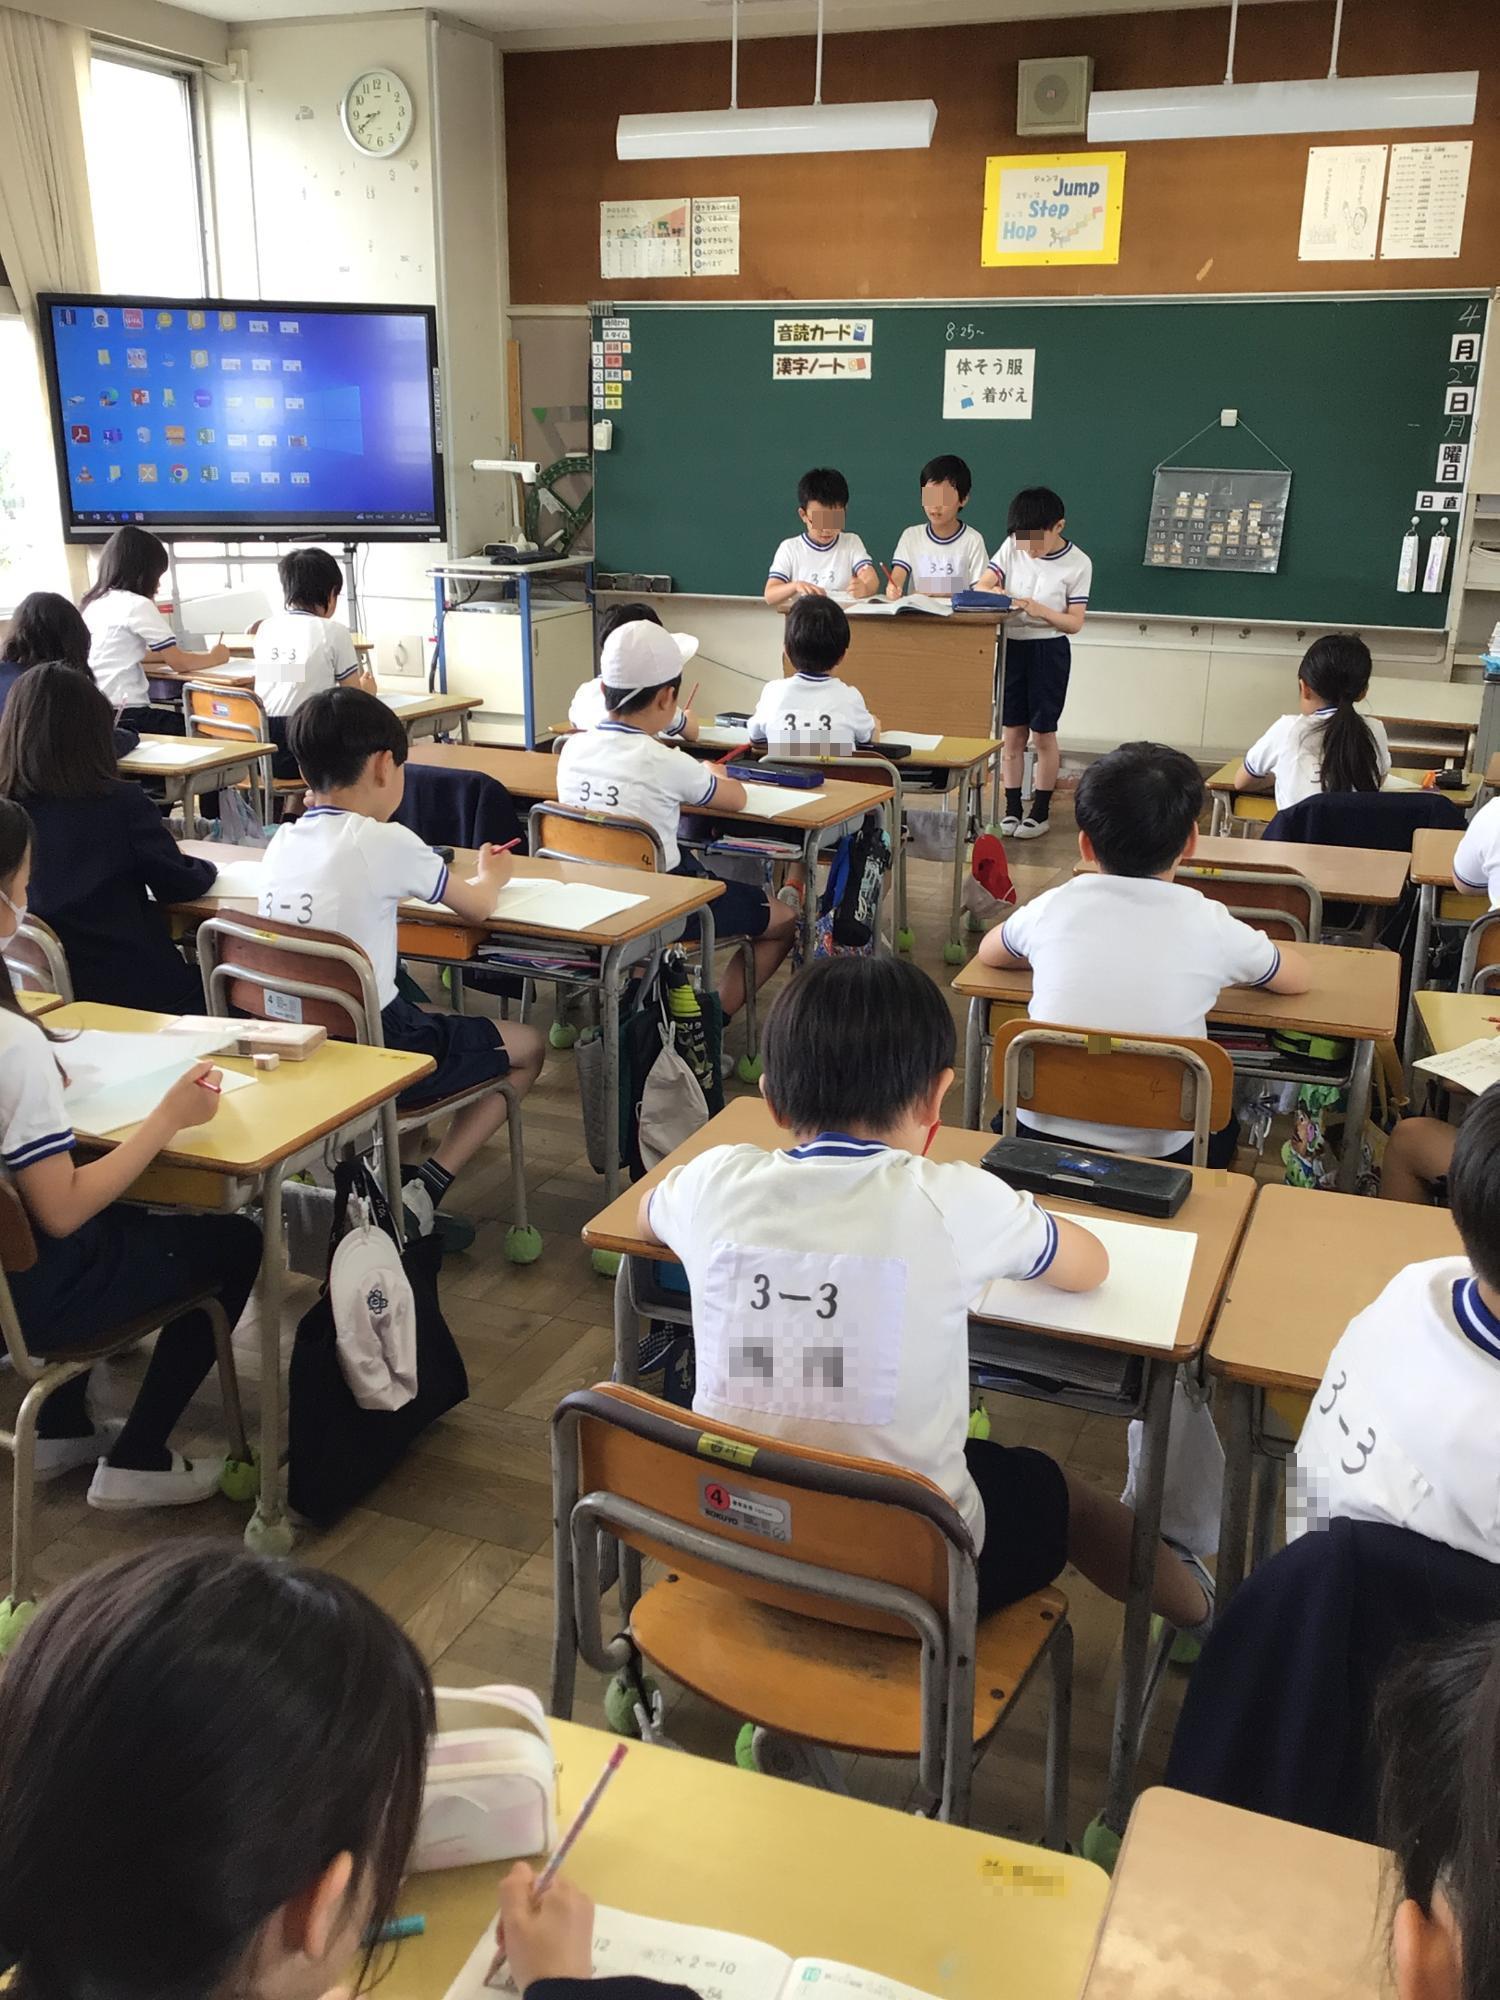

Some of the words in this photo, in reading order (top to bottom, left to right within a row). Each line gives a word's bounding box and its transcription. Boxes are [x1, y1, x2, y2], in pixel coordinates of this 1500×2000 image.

[362, 83, 370, 94] 11
[372, 79, 382, 90] 12
[386, 82, 391, 92] 1
[355, 95, 365, 106] 10
[394, 92, 400, 103] 2
[353, 110, 360, 121] 9
[398, 106, 405, 117] 3
[366, 134, 373, 144] 7
[376, 136, 384, 147] 6
[1052, 177, 1100, 198] Jump
[1028, 199, 1070, 220] Step
[1002, 220, 1038, 241] Hop
[1458, 304, 1481, 328] 4
[777, 323, 851, 342] 音読カード
[1455, 339, 1475, 361] 月
[776, 356, 846, 376] 漢字ノート
[956, 357, 1024, 376] 体そう服
[982, 386, 1028, 404] 着がえ
[1449, 392, 1469, 413] 日
[1441, 445, 1462, 481] 曜日
[1420, 495, 1459, 510] 日直
[930, 563, 954, 575] 3-3
[1188, 557, 1198, 565] 31
[811, 570, 836, 585] 3-3
[271, 647, 297, 661] 3-3
[784, 713, 832, 730] 3-3
[579, 781, 620, 807] 3-3
[1319, 1370, 1377, 1475] 3-3
[710, 1489, 723, 1505] 4
[704, 1508, 738, 1526] KOKUYO
